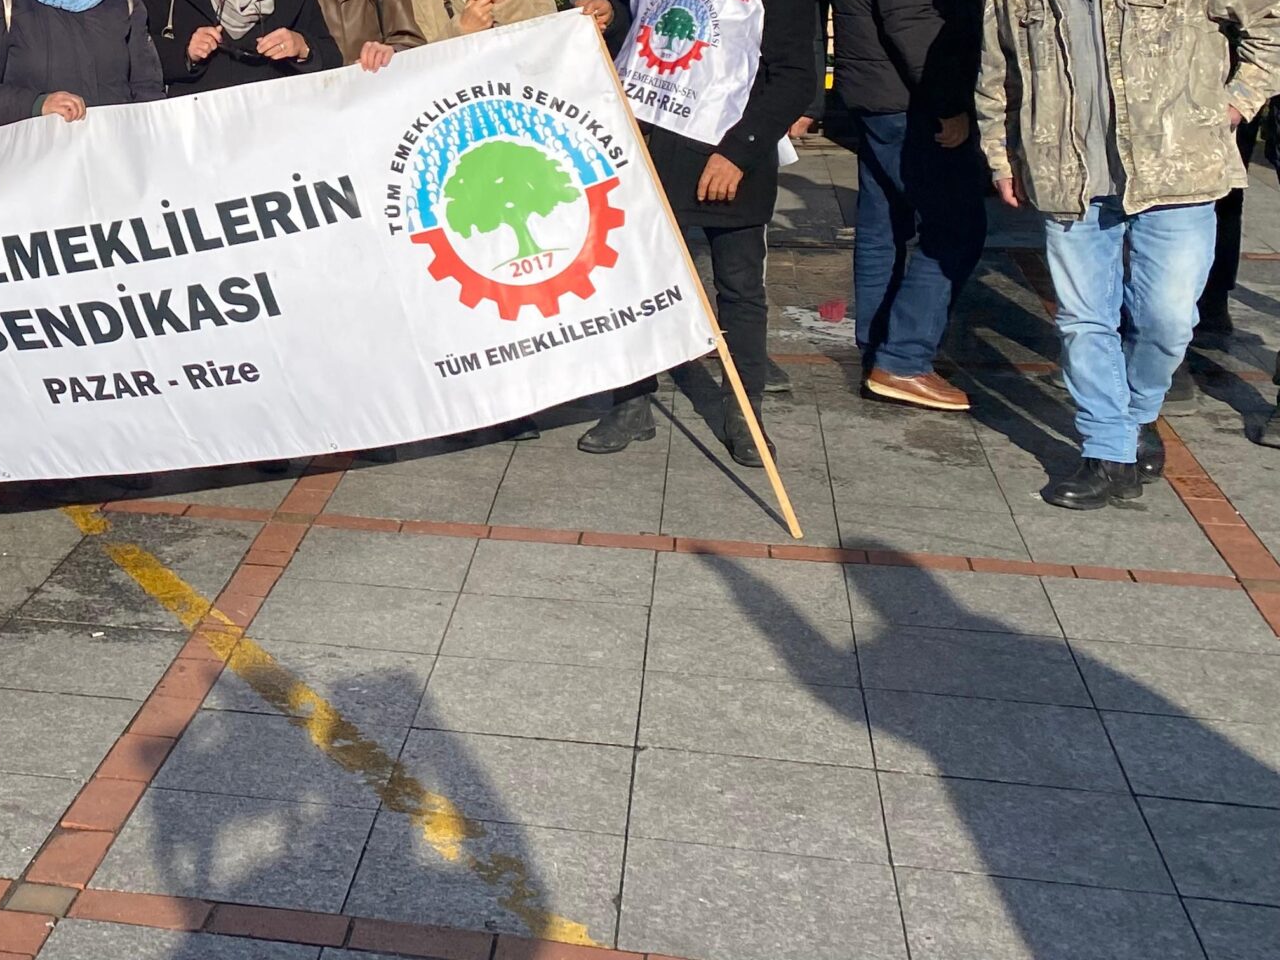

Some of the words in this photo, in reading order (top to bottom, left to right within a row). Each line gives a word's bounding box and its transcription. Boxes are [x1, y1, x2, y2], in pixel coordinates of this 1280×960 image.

[390, 80, 513, 174] EMEKLİLERİN
[521, 85, 630, 170] SENDİKASI
[384, 183, 404, 237] TÜM
[509, 251, 555, 278] 2017
[434, 351, 483, 379] TÜM
[484, 284, 685, 367] EMEKLİLERİN-SEN
[42, 368, 162, 405] PAZAR
[183, 359, 262, 392] Rize
